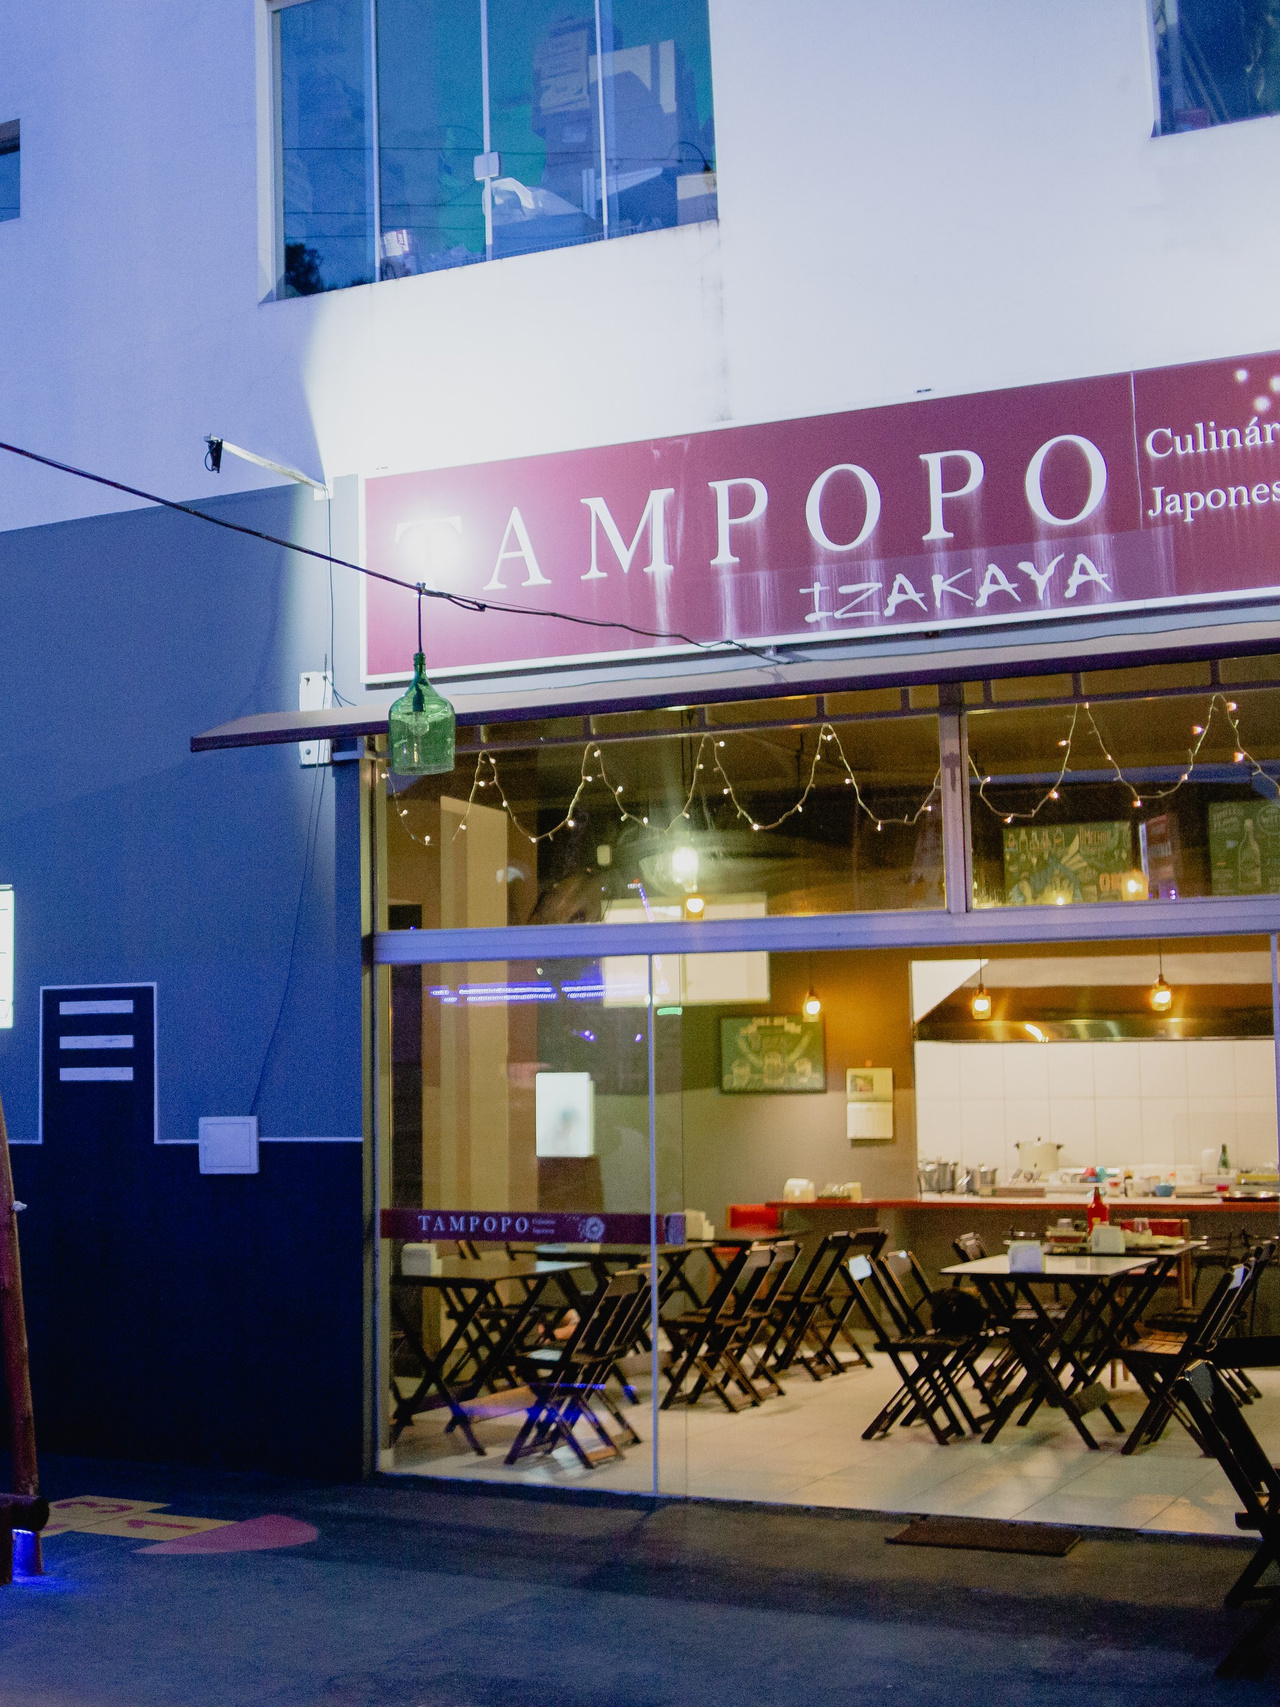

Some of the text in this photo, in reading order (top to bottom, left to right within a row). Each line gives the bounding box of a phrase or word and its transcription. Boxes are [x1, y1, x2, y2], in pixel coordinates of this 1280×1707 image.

[394, 433, 1108, 598] TAMPOPO
[799, 552, 1113, 624] IZAKAYA
[417, 1214, 530, 1234] TAMPOPO
